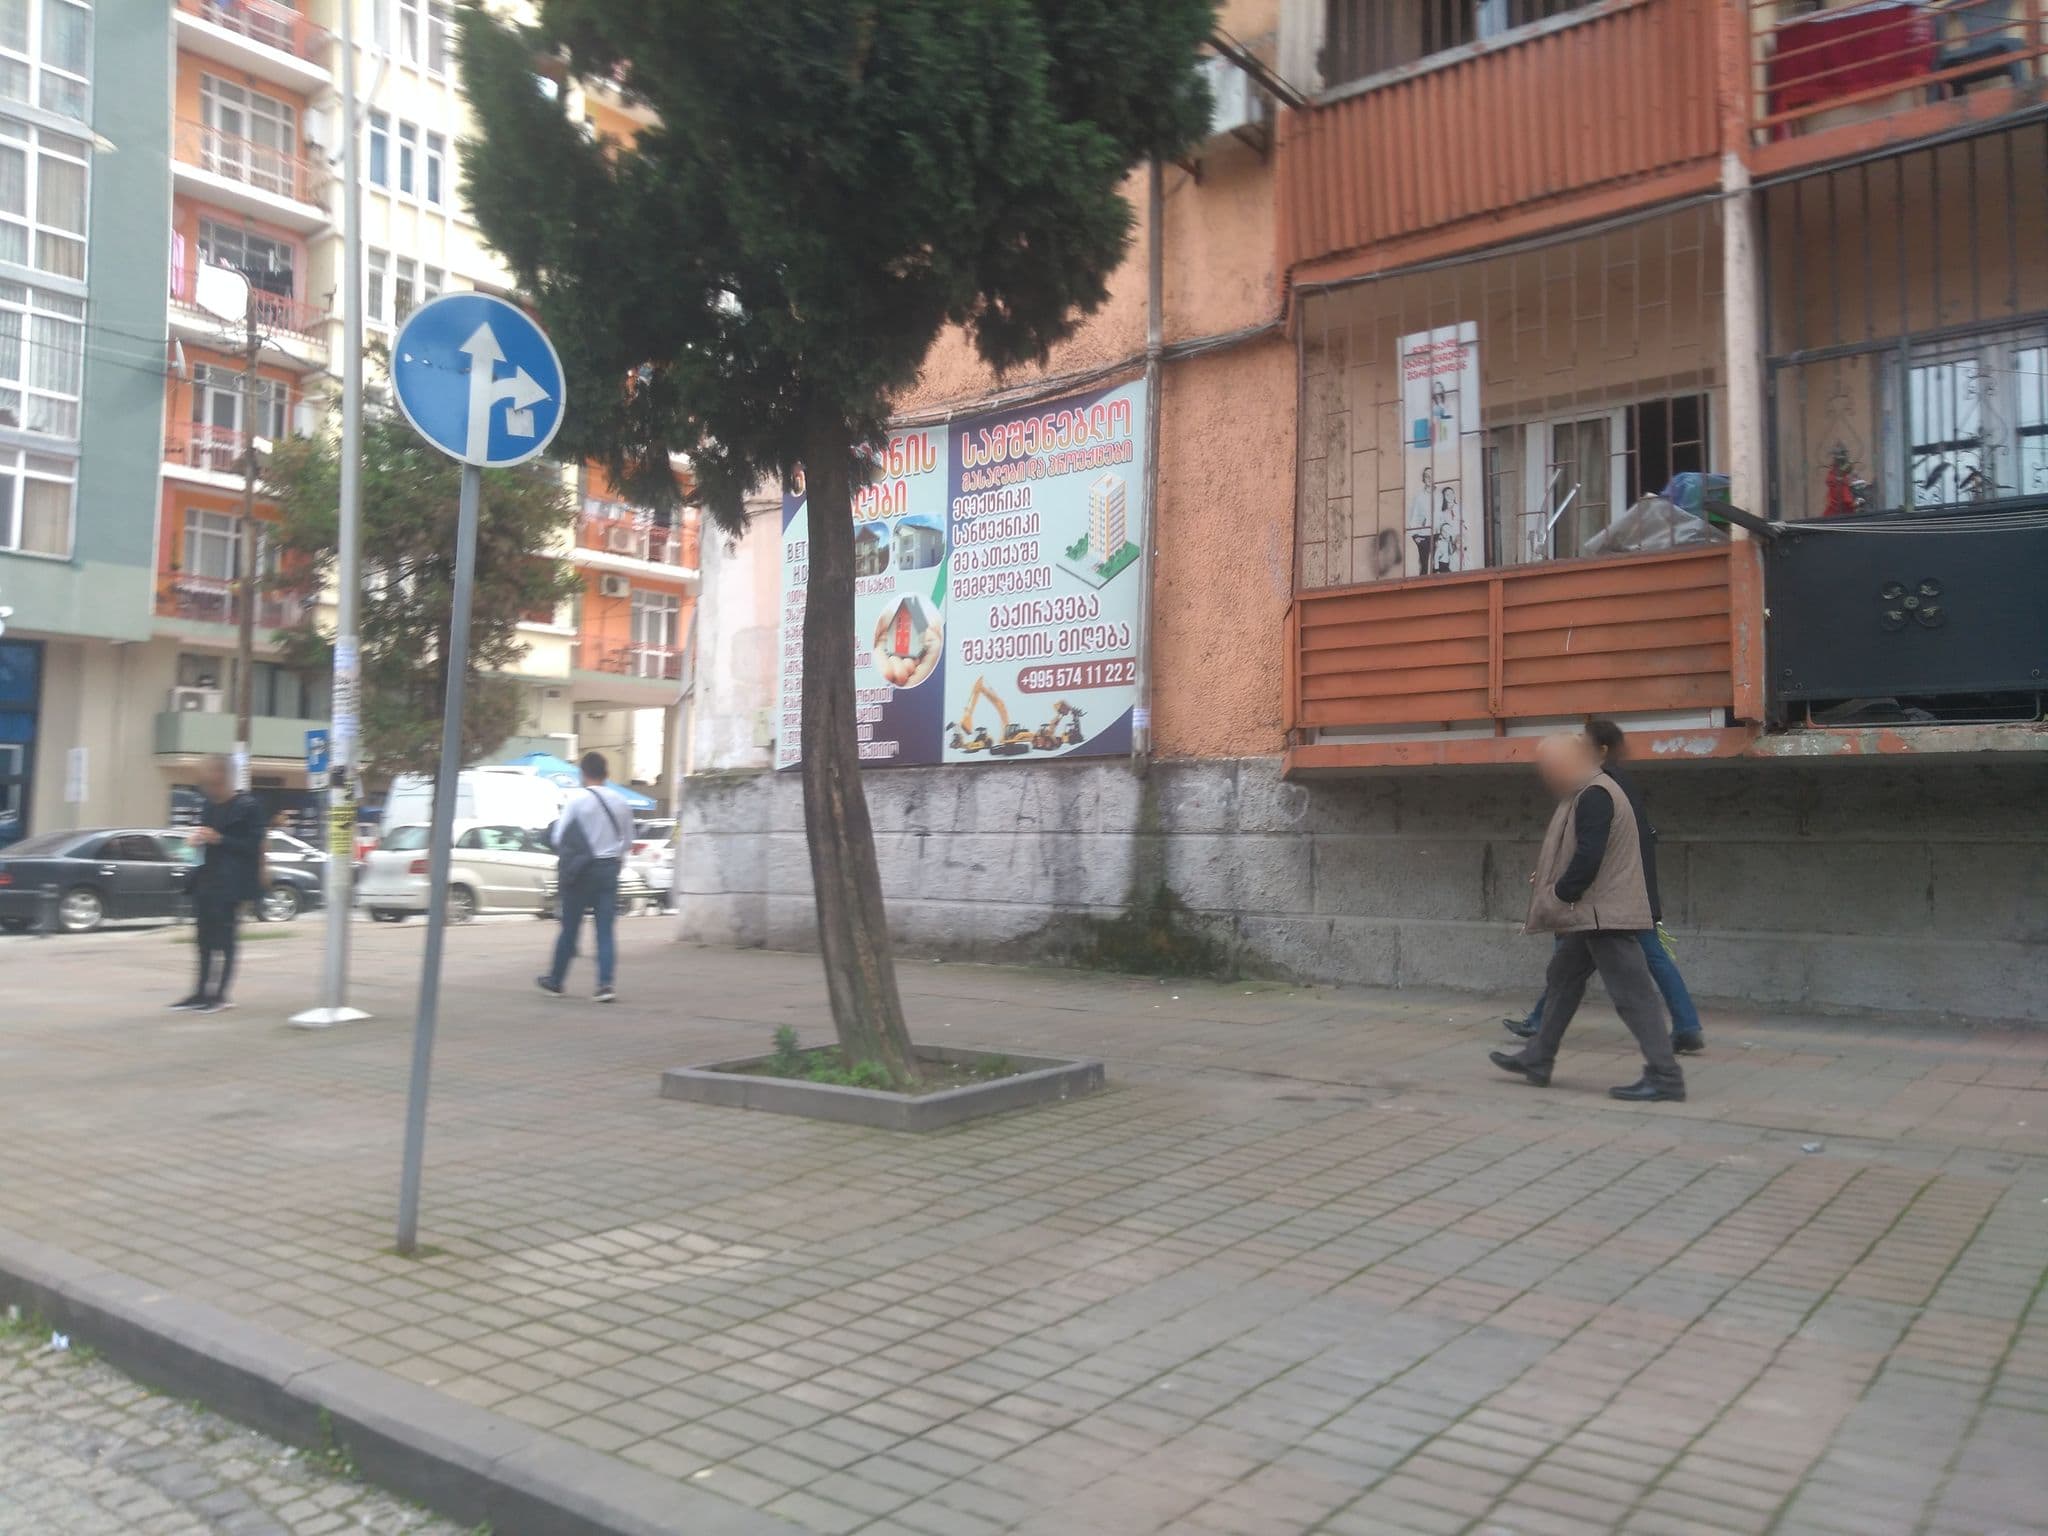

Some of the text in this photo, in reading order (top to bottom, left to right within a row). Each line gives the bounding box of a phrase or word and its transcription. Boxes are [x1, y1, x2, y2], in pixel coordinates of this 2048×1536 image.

[962, 398, 1132, 468] სამშენებლო
[962, 462, 1026, 491] მასალები
[1027, 457, 1046, 480] და
[953, 486, 1031, 519] ელექტრიკი
[953, 512, 1040, 546] სანტექნიკი
[953, 566, 1051, 599] შემდუღებელი
[990, 595, 1099, 629] გაქირავება
[963, 623, 1130, 662] შეკვეთის მიღება
[1021, 670, 1054, 689] +995
[1056, 666, 1082, 687] 574
[1086, 664, 1101, 684] 11
[1105, 662, 1123, 682] 22
